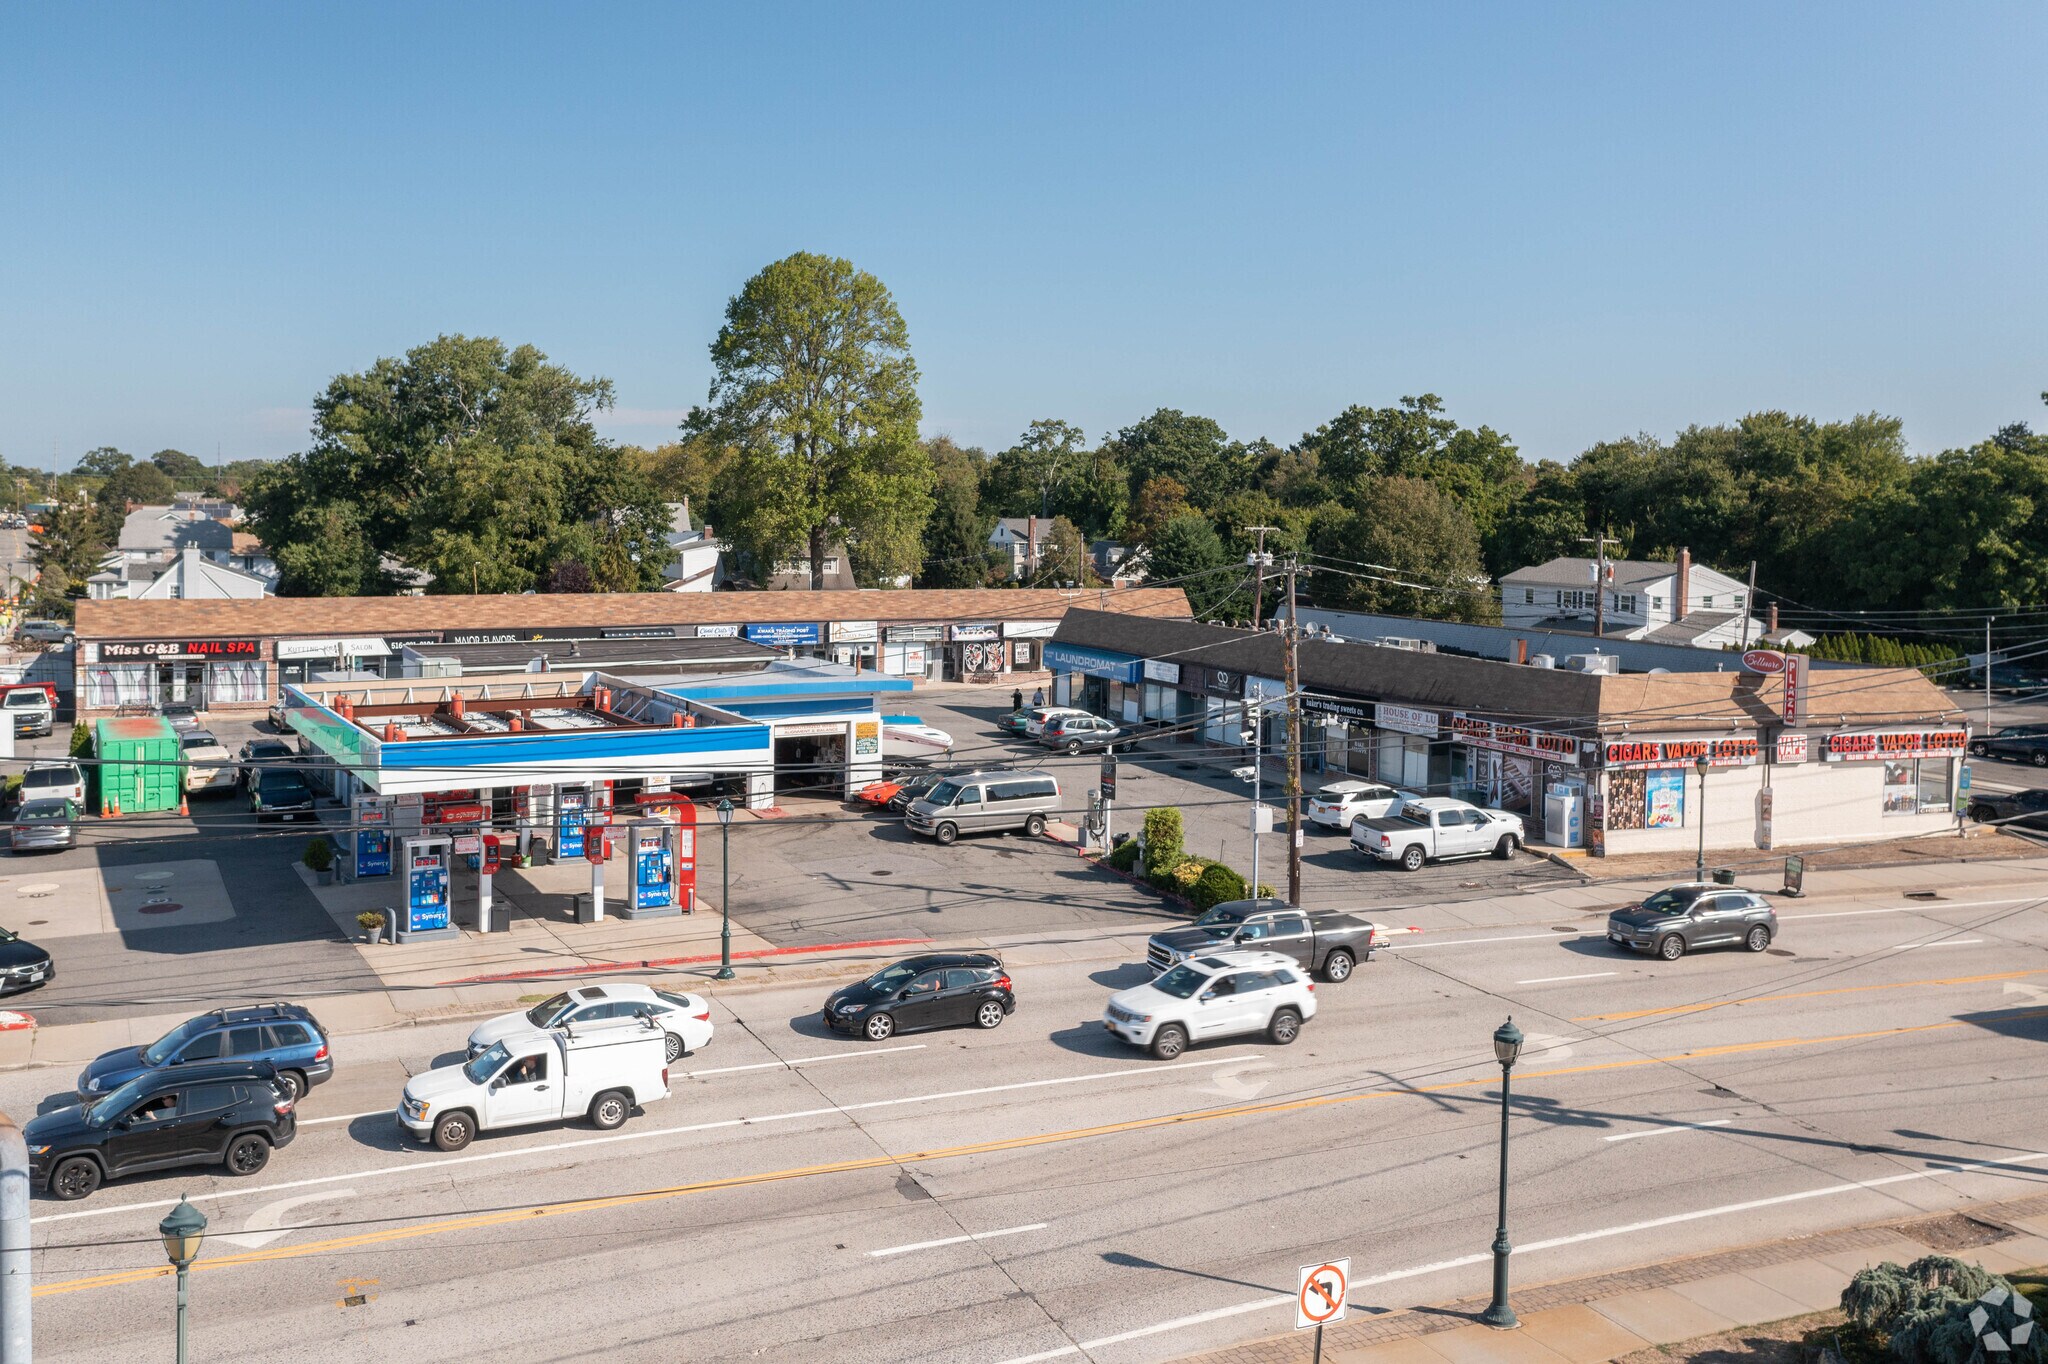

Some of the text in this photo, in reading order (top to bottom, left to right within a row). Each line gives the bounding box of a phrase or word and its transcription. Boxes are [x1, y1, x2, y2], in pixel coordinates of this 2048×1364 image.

[483, 634, 516, 643] FLAVORS
[104, 642, 255, 656] Miss G&B NAIL SPA
[350, 643, 373, 651] SALON
[1055, 651, 1117, 672] LAUNDROMAT
[1747, 653, 1779, 669] Bellmore
[1787, 661, 1796, 720] PLAZA
[1306, 699, 1322, 708] baker's
[1323, 701, 1340, 713] trading
[1341, 704, 1357, 715] sweets
[1383, 706, 1437, 724] HOUSE OF LU
[1452, 717, 1490, 739] CIGARS
[1496, 725, 1529, 746] VAPOR
[1537, 733, 1575, 754] LOTTO
[1831, 732, 1967, 753] CIGARS VAPOR LOTTO
[1607, 739, 1759, 762] CIGARS VAPOR LOTTO
[1779, 736, 1806, 755] VAPE
[367, 860, 389, 868] Synergy
[647, 890, 669, 898] Synergy
[421, 912, 446, 920] Synergy
